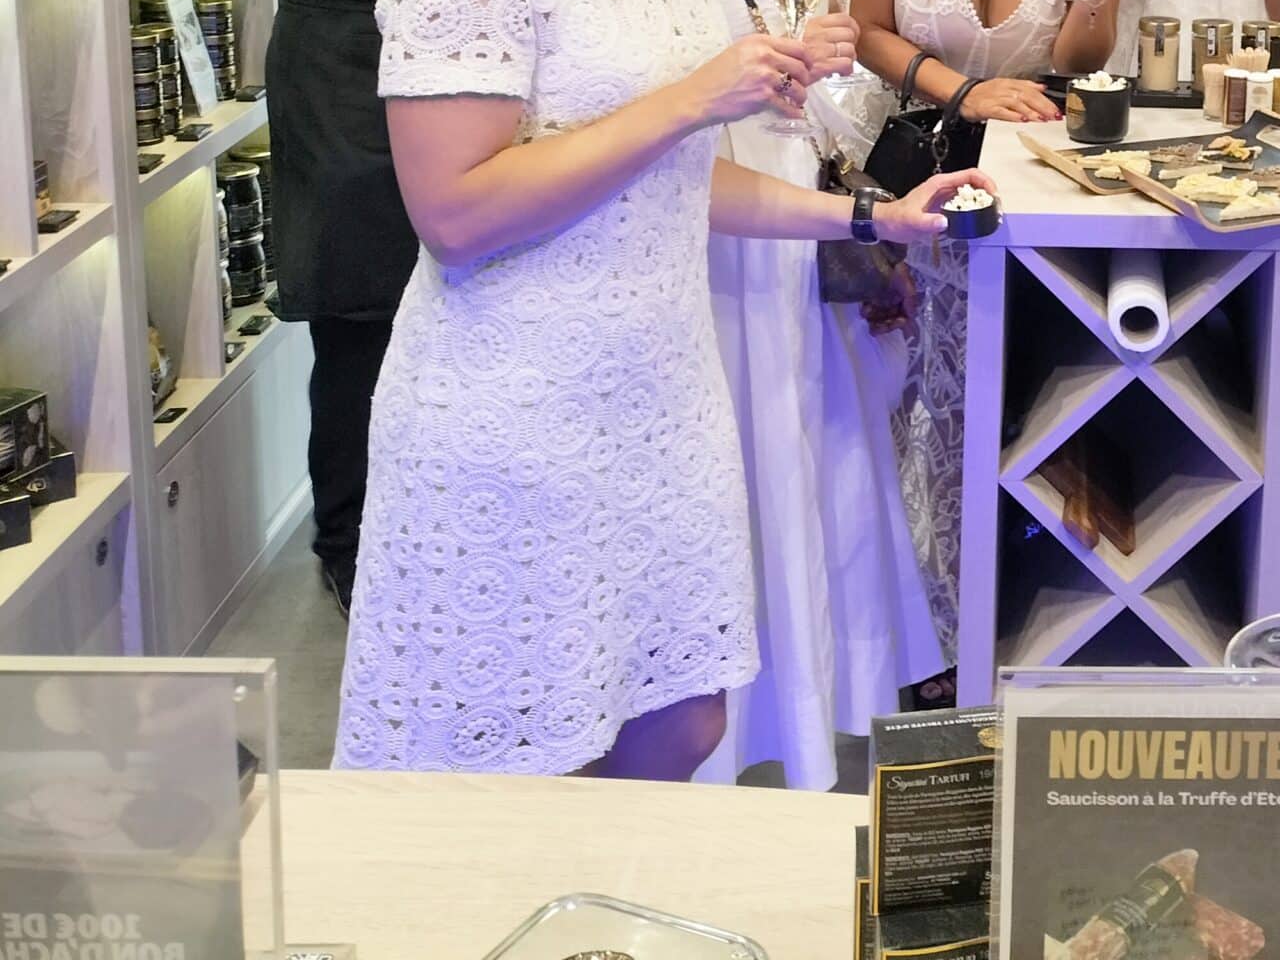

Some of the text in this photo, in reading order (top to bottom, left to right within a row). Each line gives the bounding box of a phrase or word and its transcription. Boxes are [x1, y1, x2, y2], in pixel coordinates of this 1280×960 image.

[929, 772, 970, 786] TARTUFI
[1046, 790, 1139, 807] Saucisson
[1142, 792, 1155, 806] à
[1158, 791, 1175, 806] la
[1178, 791, 1238, 807] Truffe
